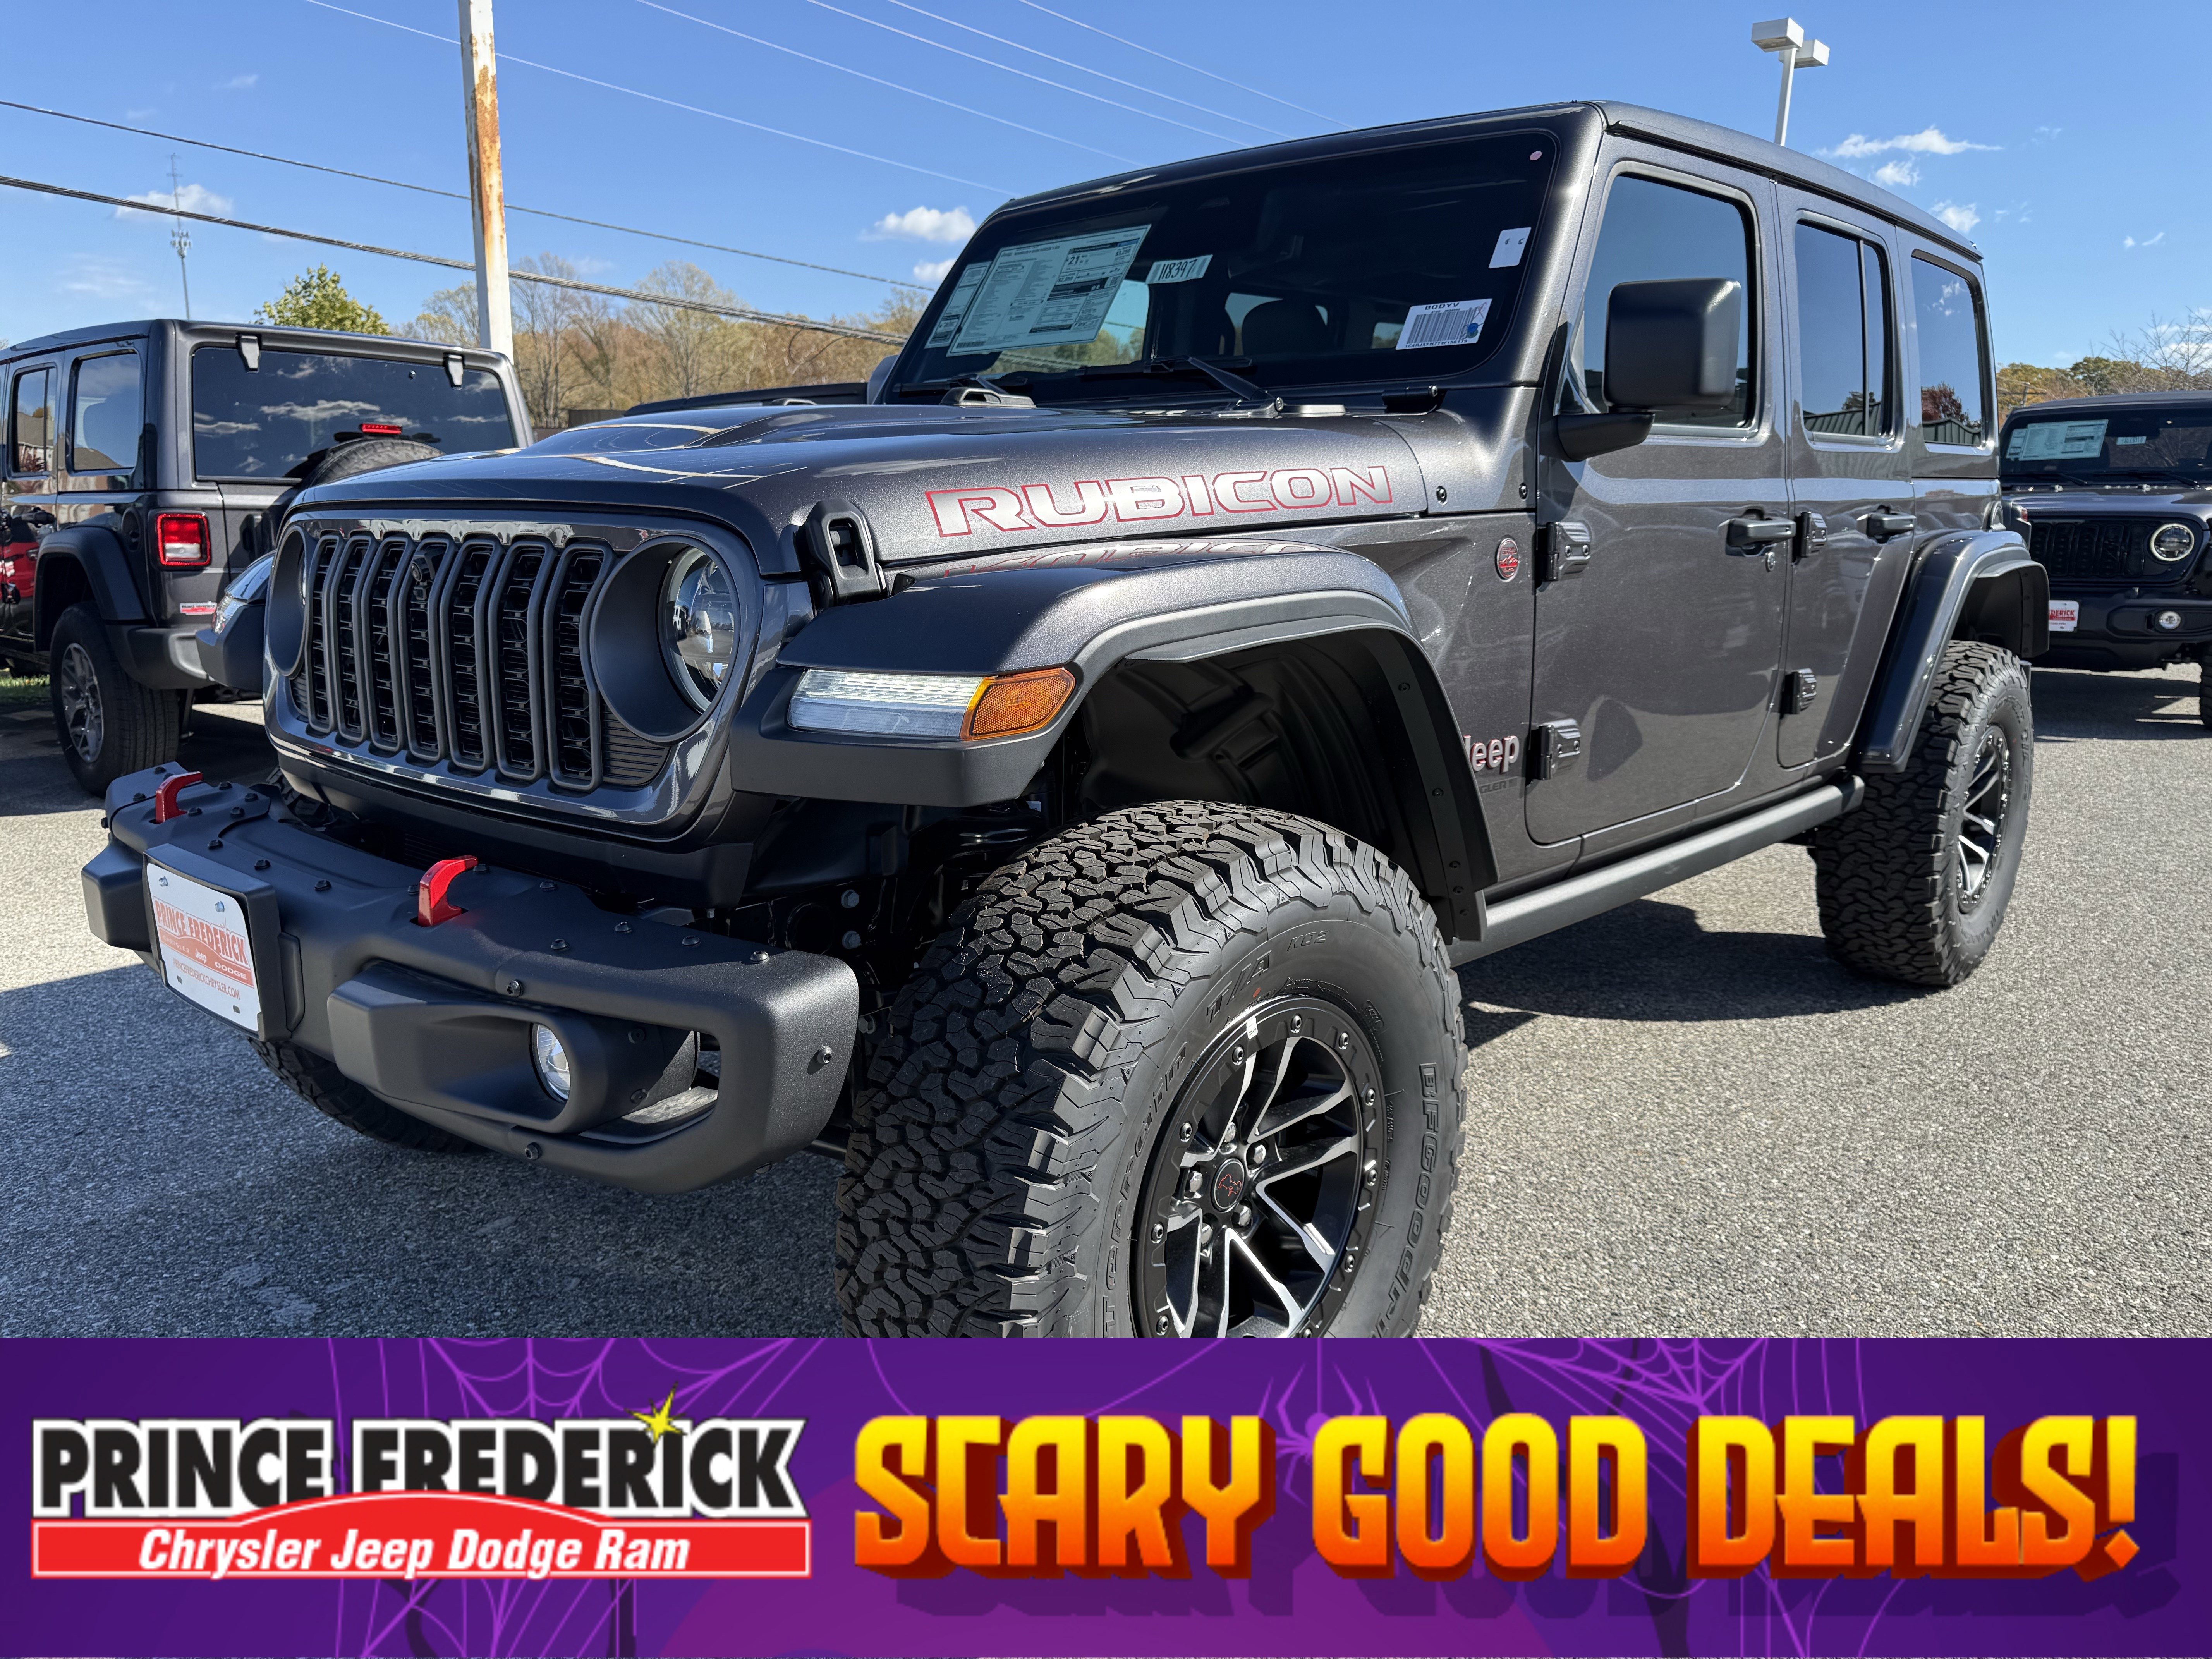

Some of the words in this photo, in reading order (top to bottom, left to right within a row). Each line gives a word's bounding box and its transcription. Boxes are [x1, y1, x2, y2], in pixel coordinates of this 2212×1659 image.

[1068, 256, 1080, 265] 21
[1158, 259, 1198, 281] 118397
[925, 466, 1393, 538] RUBICON
[155, 899, 187, 936] PRINCE
[187, 916, 248, 965] FREDERICK
[195, 948, 207, 963] Jeep
[215, 962, 247, 980] DODGE
[1206, 950, 1272, 1023] T/A
[1287, 930, 1329, 951] KO2
[1371, 1062, 1438, 1338] BFGoodri
